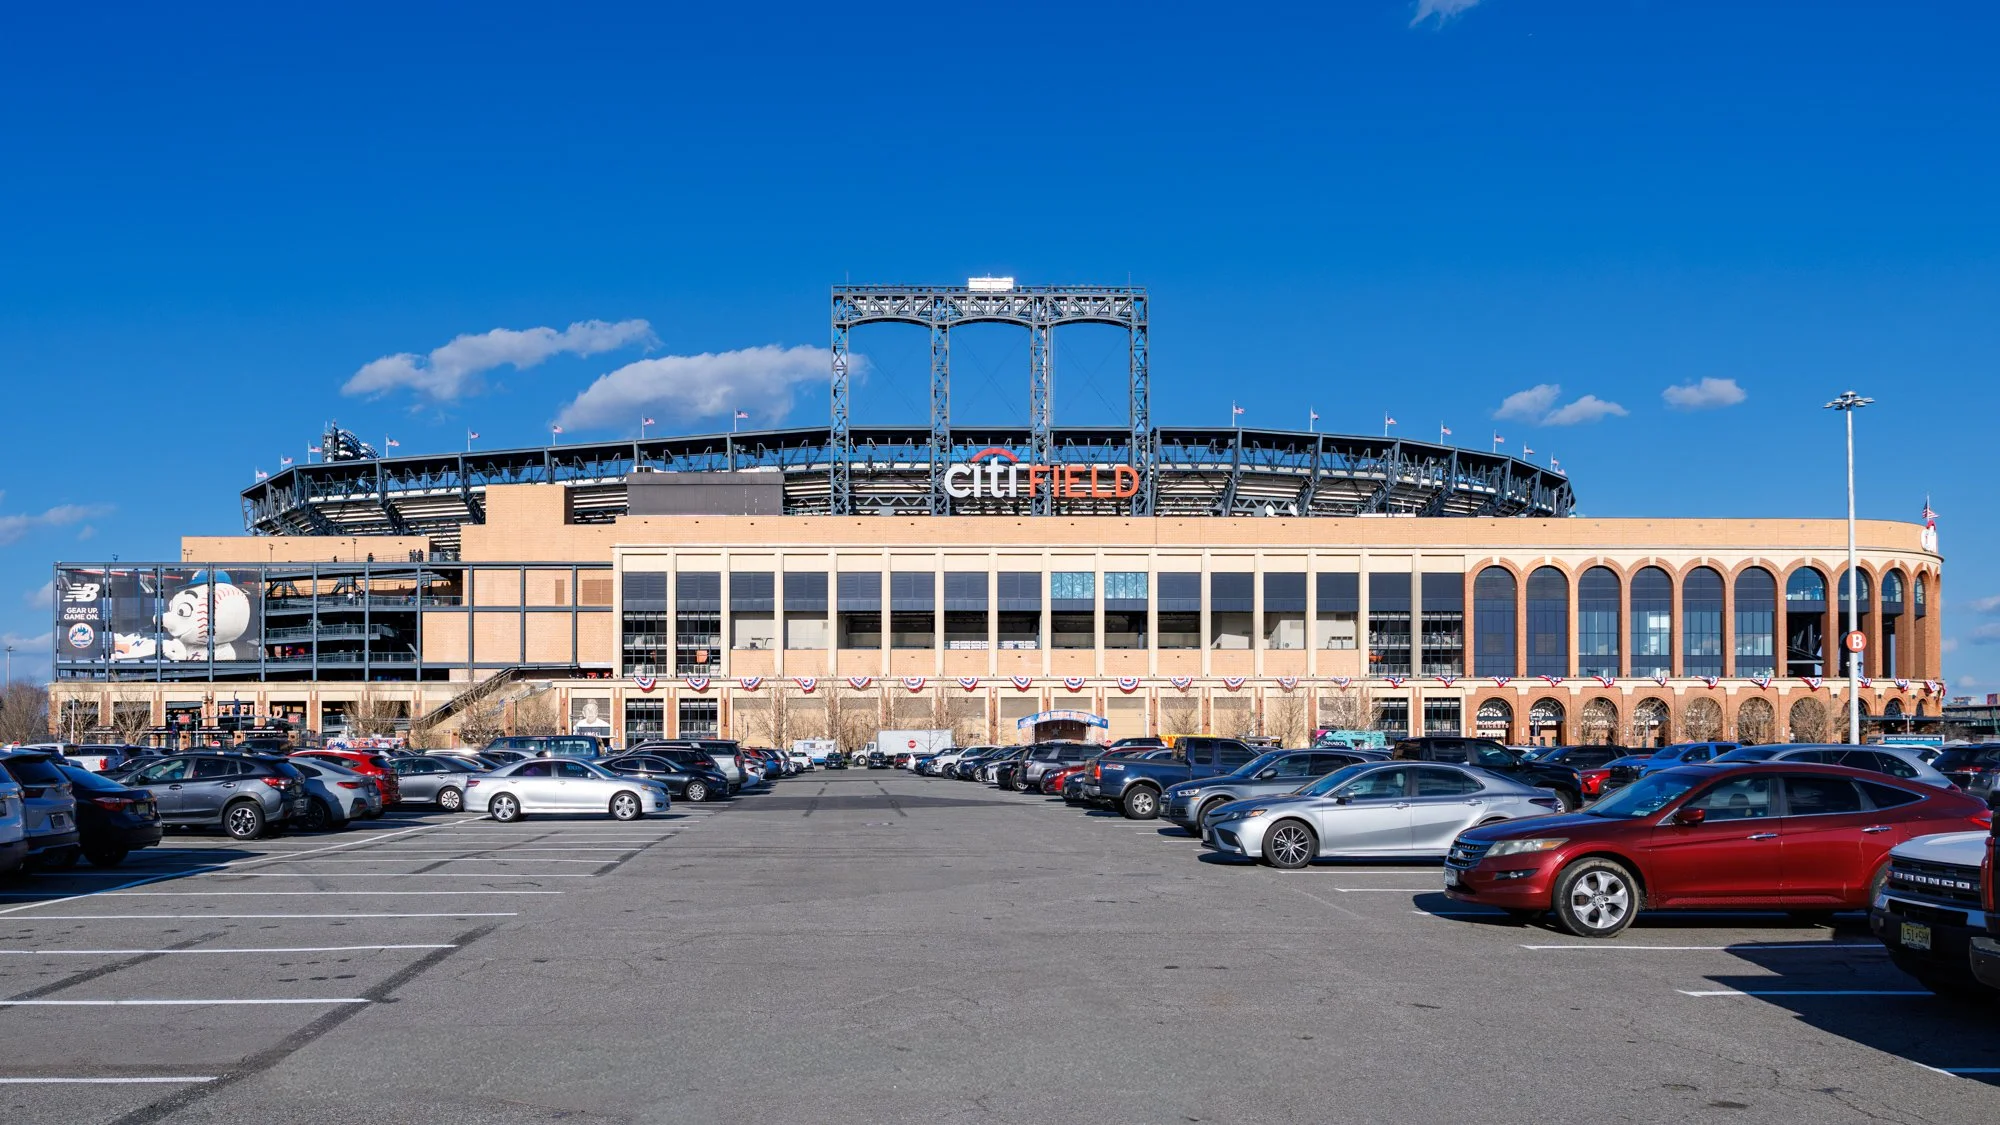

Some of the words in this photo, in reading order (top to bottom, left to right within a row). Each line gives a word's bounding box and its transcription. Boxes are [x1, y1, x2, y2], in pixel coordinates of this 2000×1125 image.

[944, 457, 1017, 499] citi
[1029, 465, 1140, 498] FIELD
[1852, 634, 1863, 649] B
[200, 704, 235, 719] LEFT
[240, 704, 284, 719] FIELD
[1893, 871, 1971, 890] BRONCO
